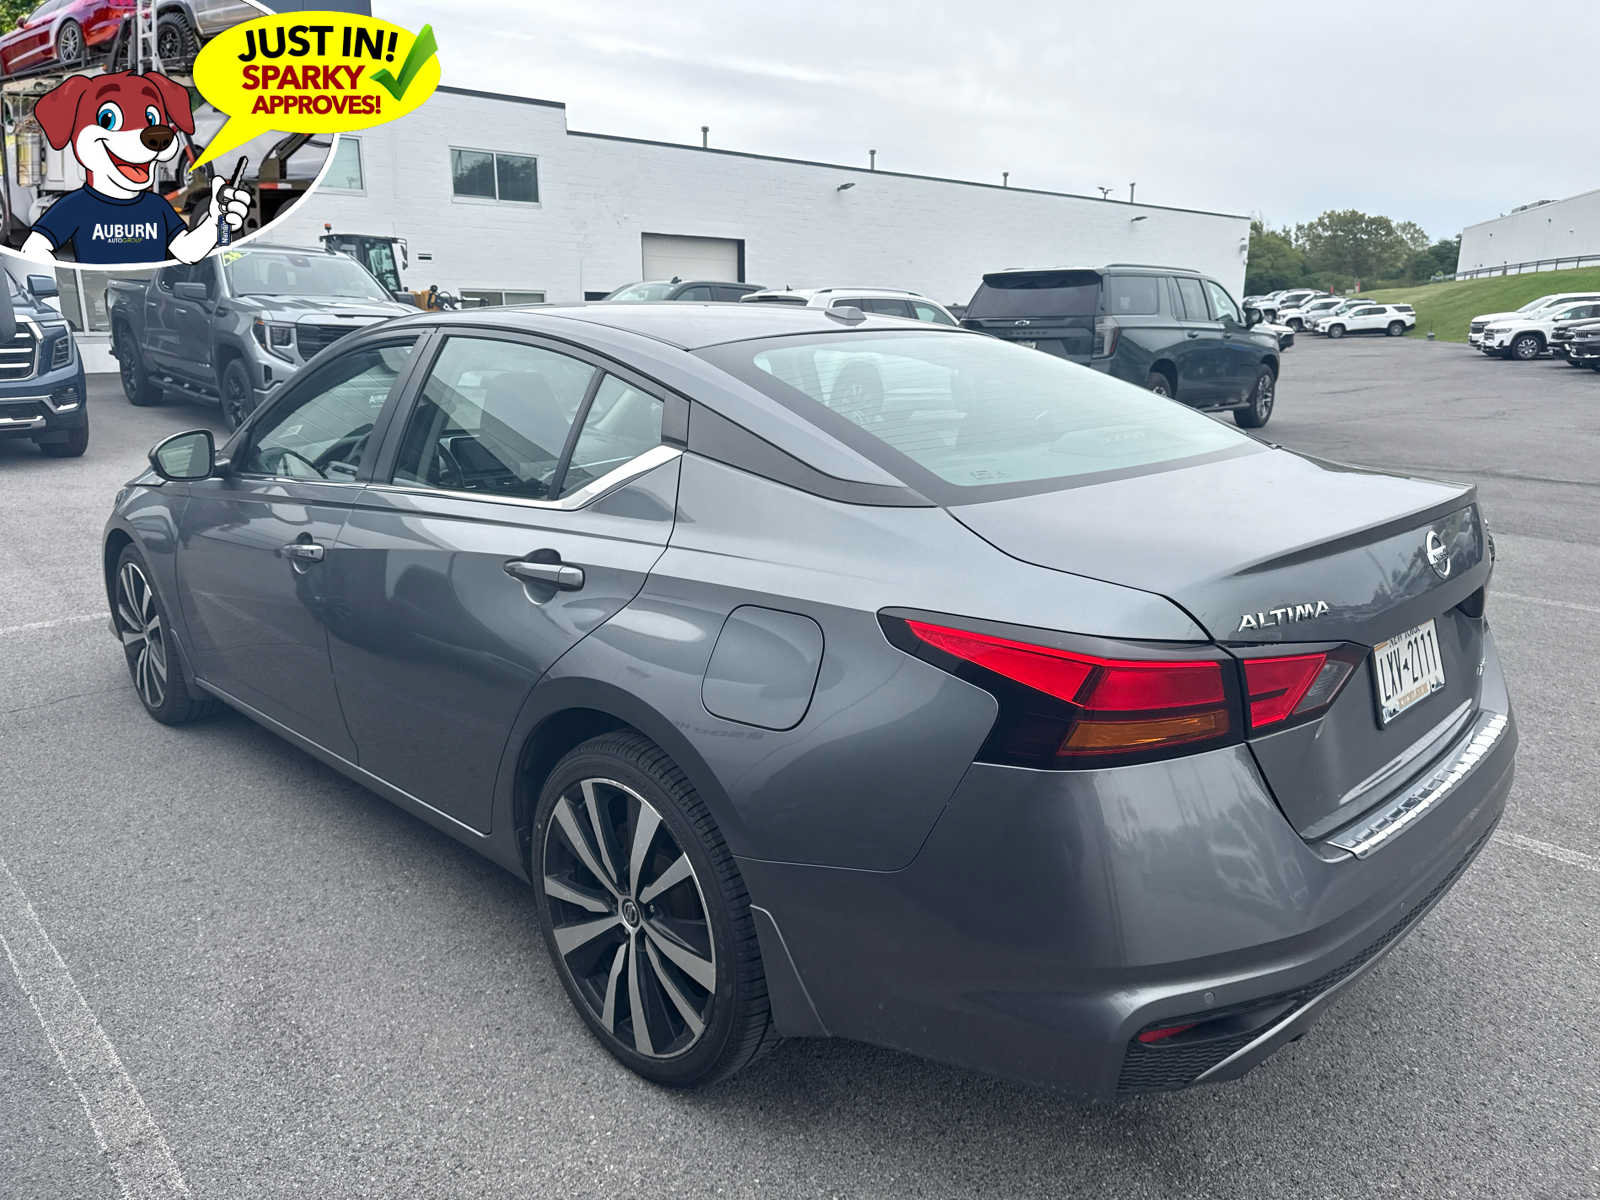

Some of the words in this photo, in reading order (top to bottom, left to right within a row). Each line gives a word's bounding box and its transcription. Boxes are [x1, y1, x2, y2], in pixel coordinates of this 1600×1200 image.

[1238, 600, 1329, 632] ALTIMA
[1380, 647, 1403, 702] LXV
[1407, 629, 1437, 683] 2111
